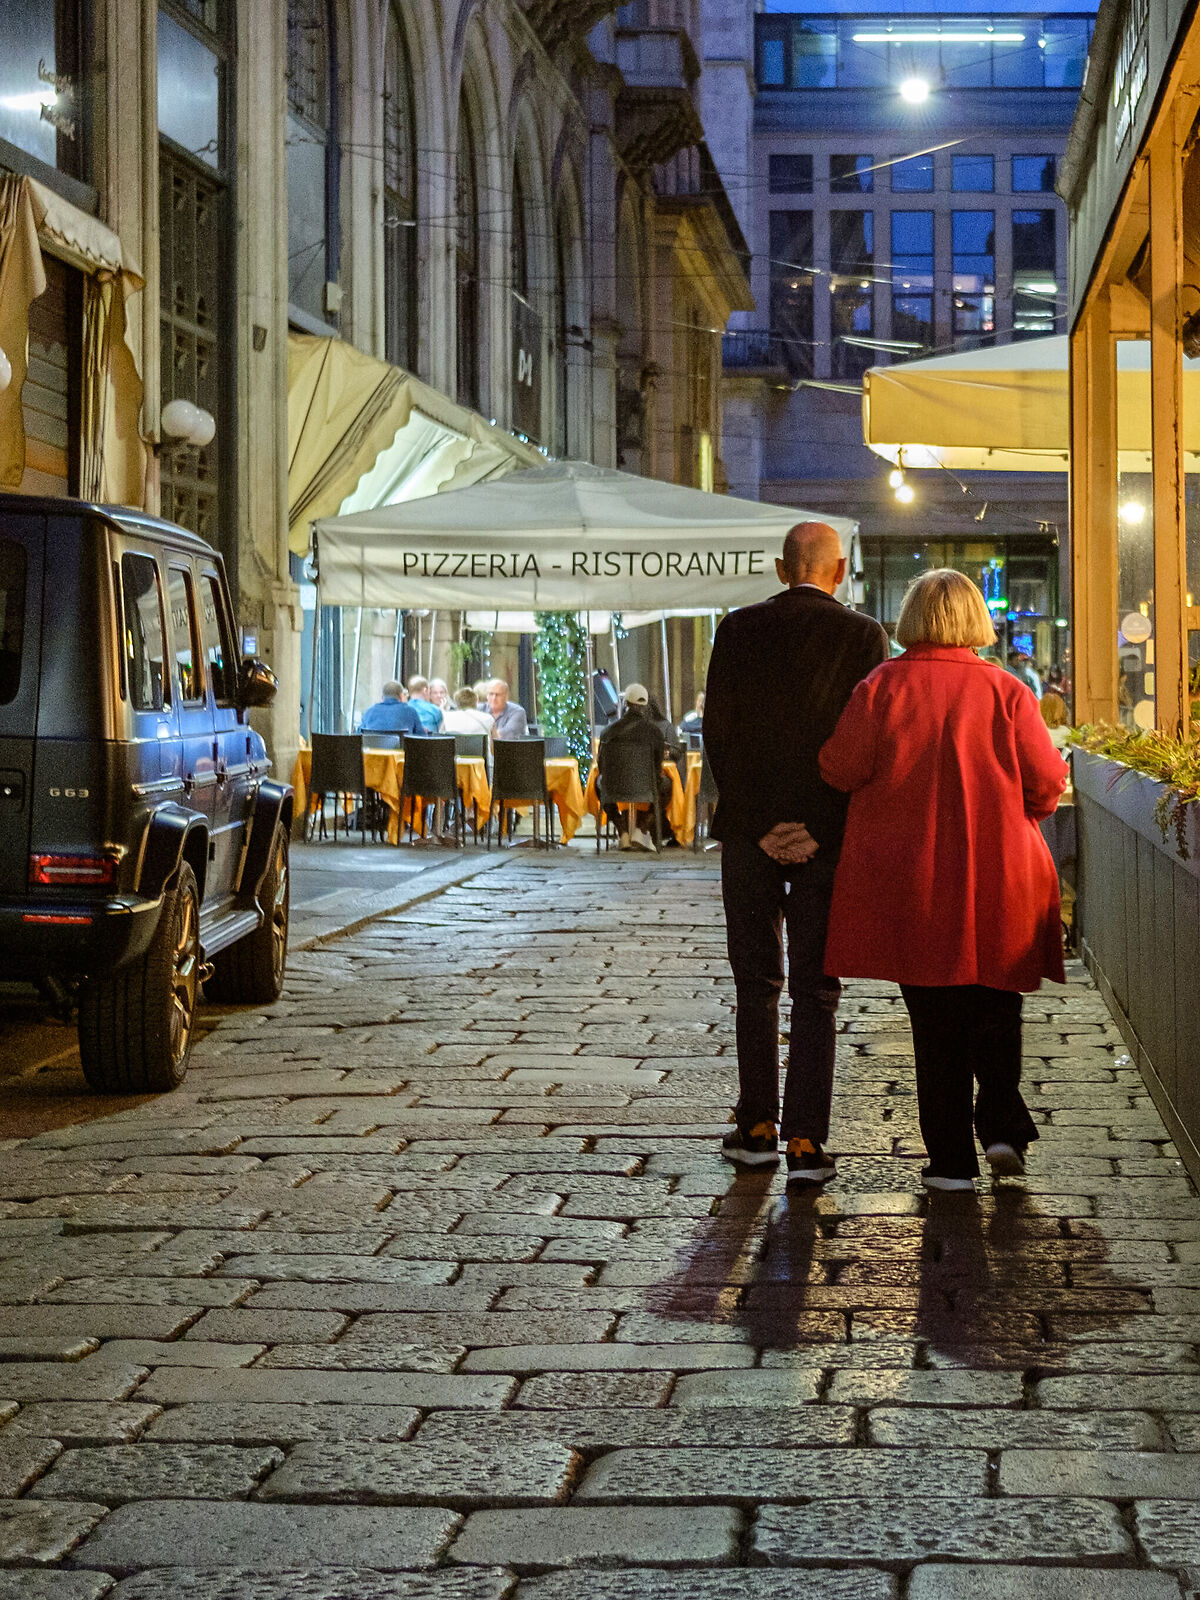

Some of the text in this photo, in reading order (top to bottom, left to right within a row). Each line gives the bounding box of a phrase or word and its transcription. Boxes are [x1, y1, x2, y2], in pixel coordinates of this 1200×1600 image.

[402, 552, 541, 578] PIZZERIA
[571, 550, 765, 577] RISTORANTE
[50, 788, 89, 798] G 63
